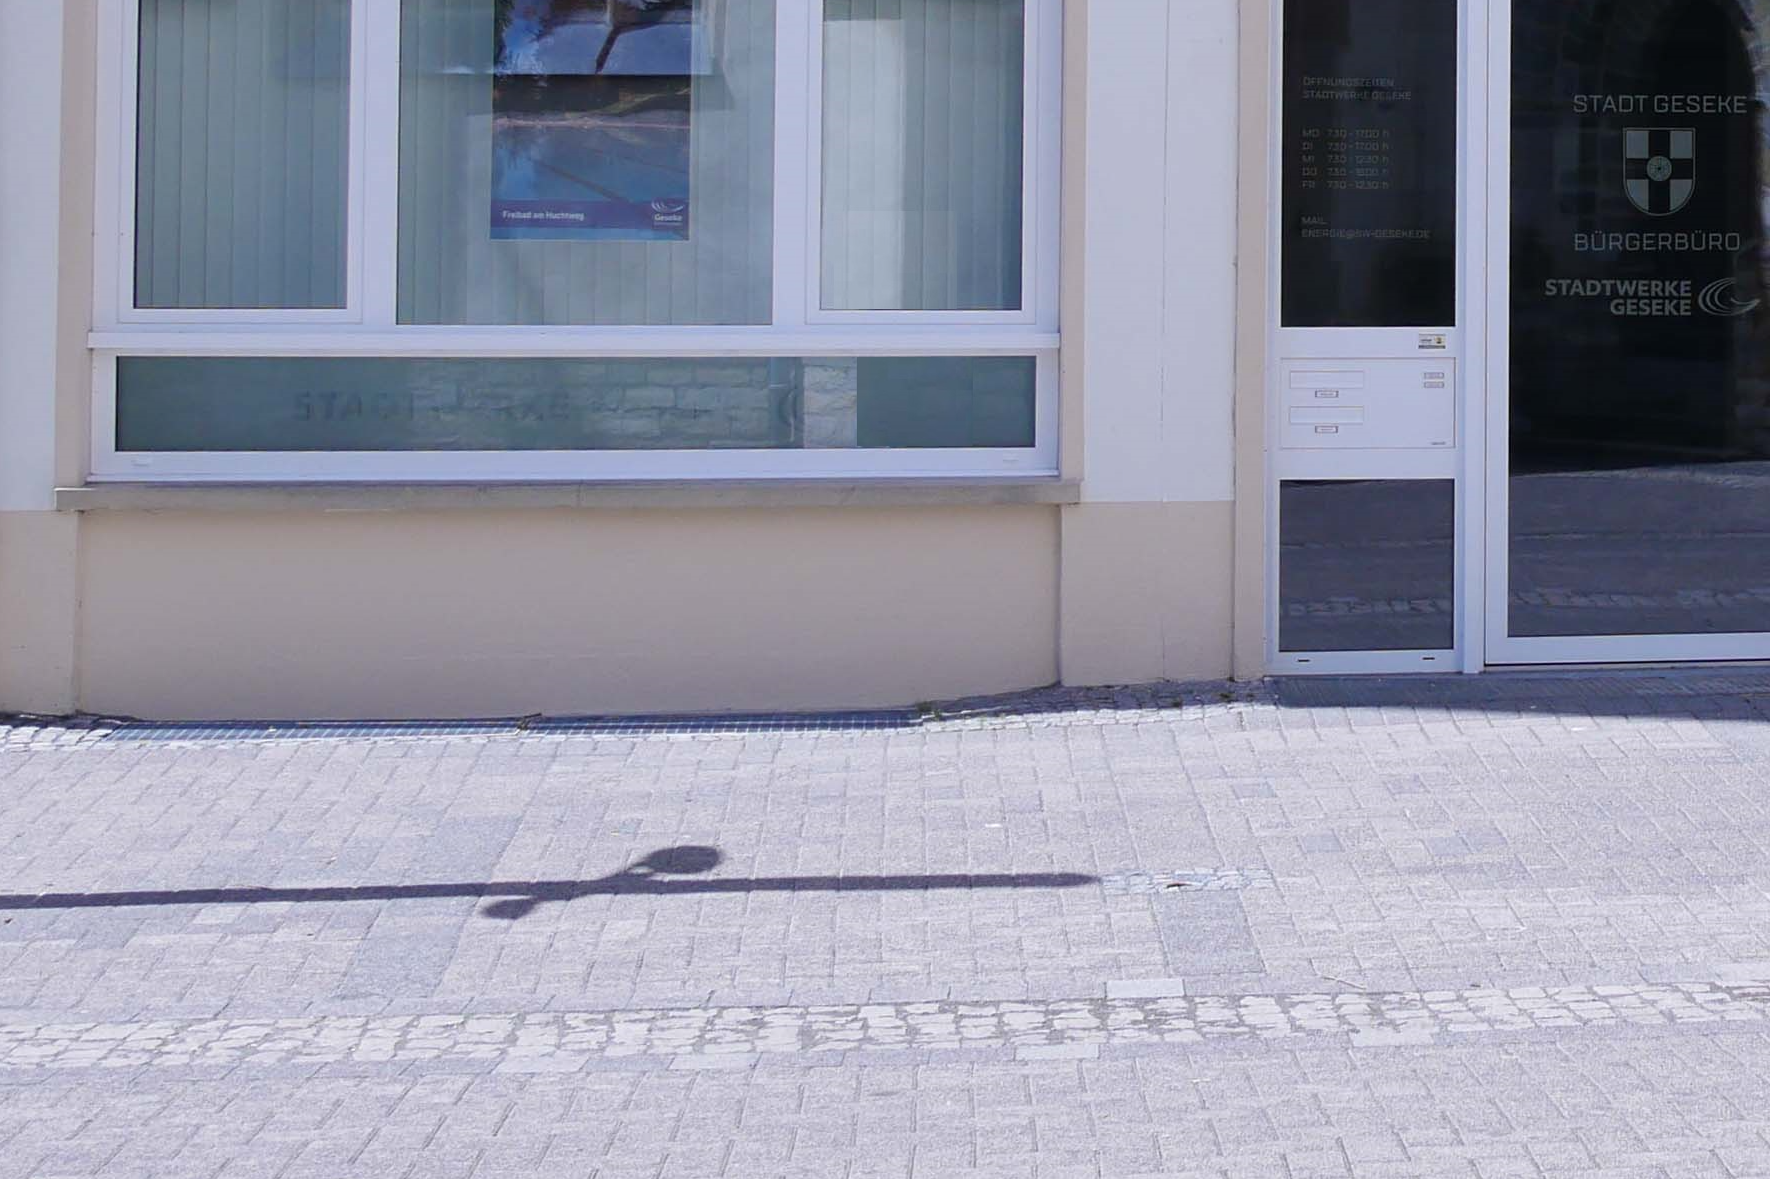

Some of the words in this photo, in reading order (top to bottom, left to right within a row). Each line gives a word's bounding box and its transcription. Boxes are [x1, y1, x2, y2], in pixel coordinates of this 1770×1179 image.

[1572, 94, 1649, 114] STADT
[1653, 94, 1748, 115] GESEKE
[1574, 230, 1741, 252] BÜRGERBÜRO
[1544, 279, 1692, 297] STADTWERKE
[1610, 298, 1692, 316] GESEKE
